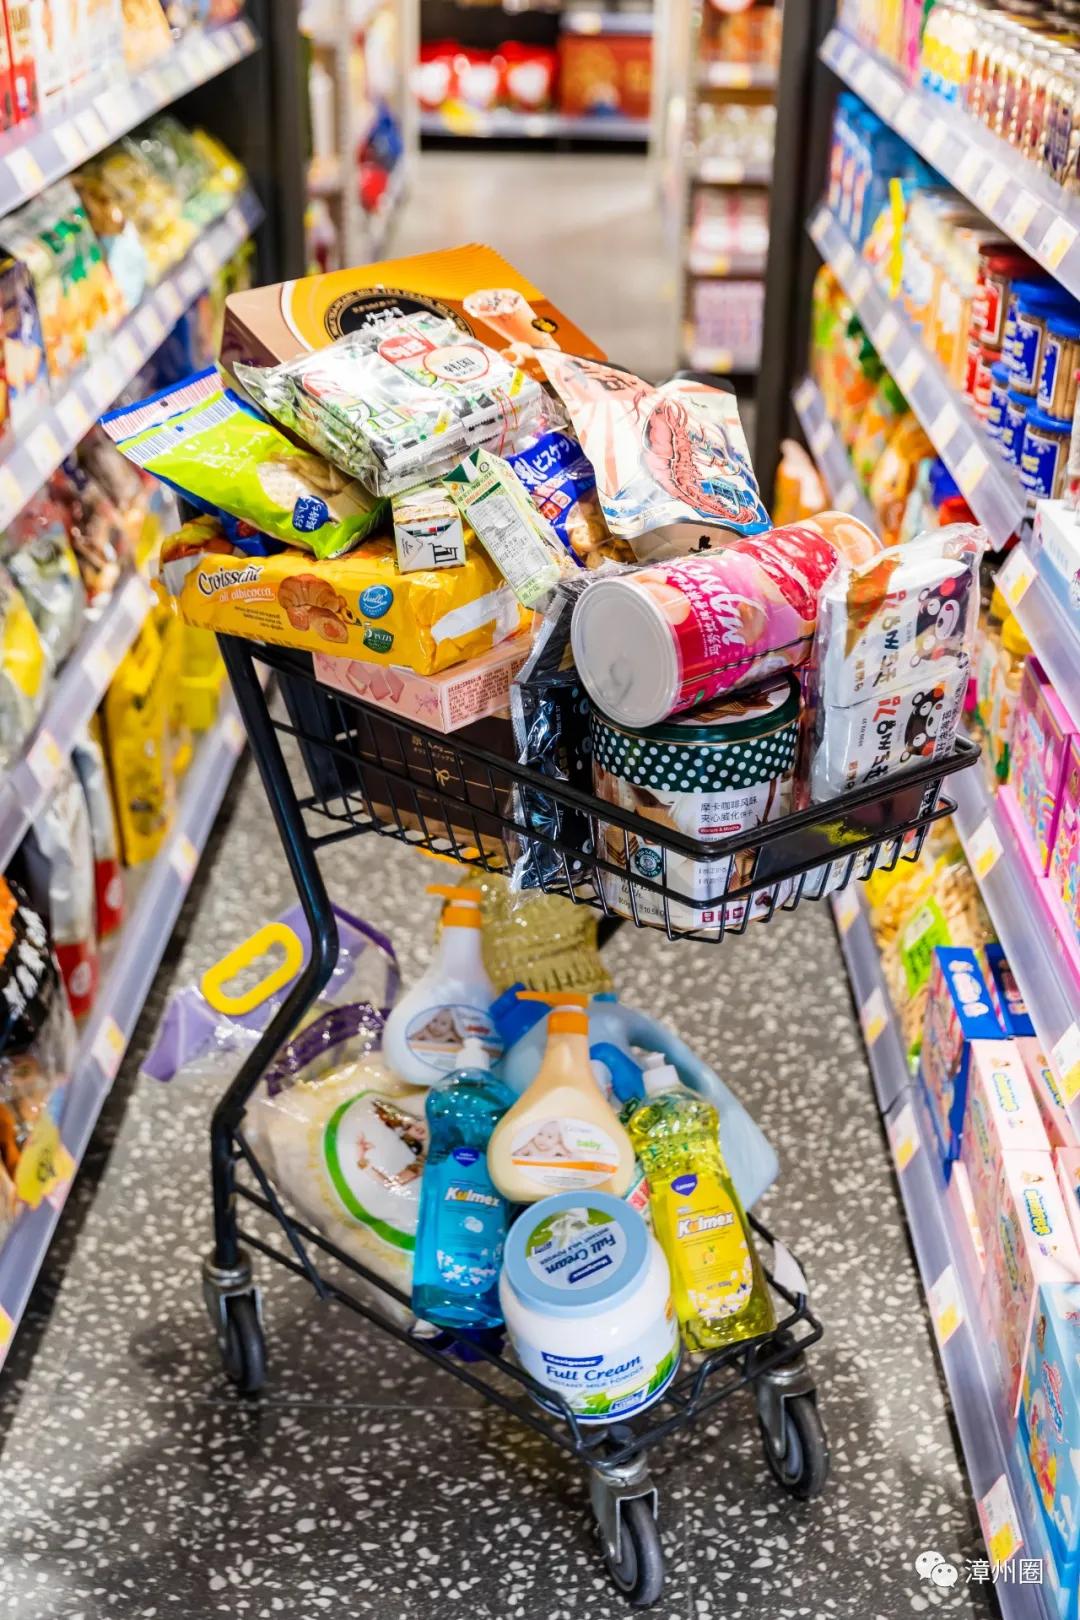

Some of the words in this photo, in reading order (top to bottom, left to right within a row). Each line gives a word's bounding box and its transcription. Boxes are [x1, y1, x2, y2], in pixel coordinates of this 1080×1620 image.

[545, 1248, 590, 1275] Cream
[545, 1365, 578, 1381] Full
[583, 1355, 641, 1381] Cream
